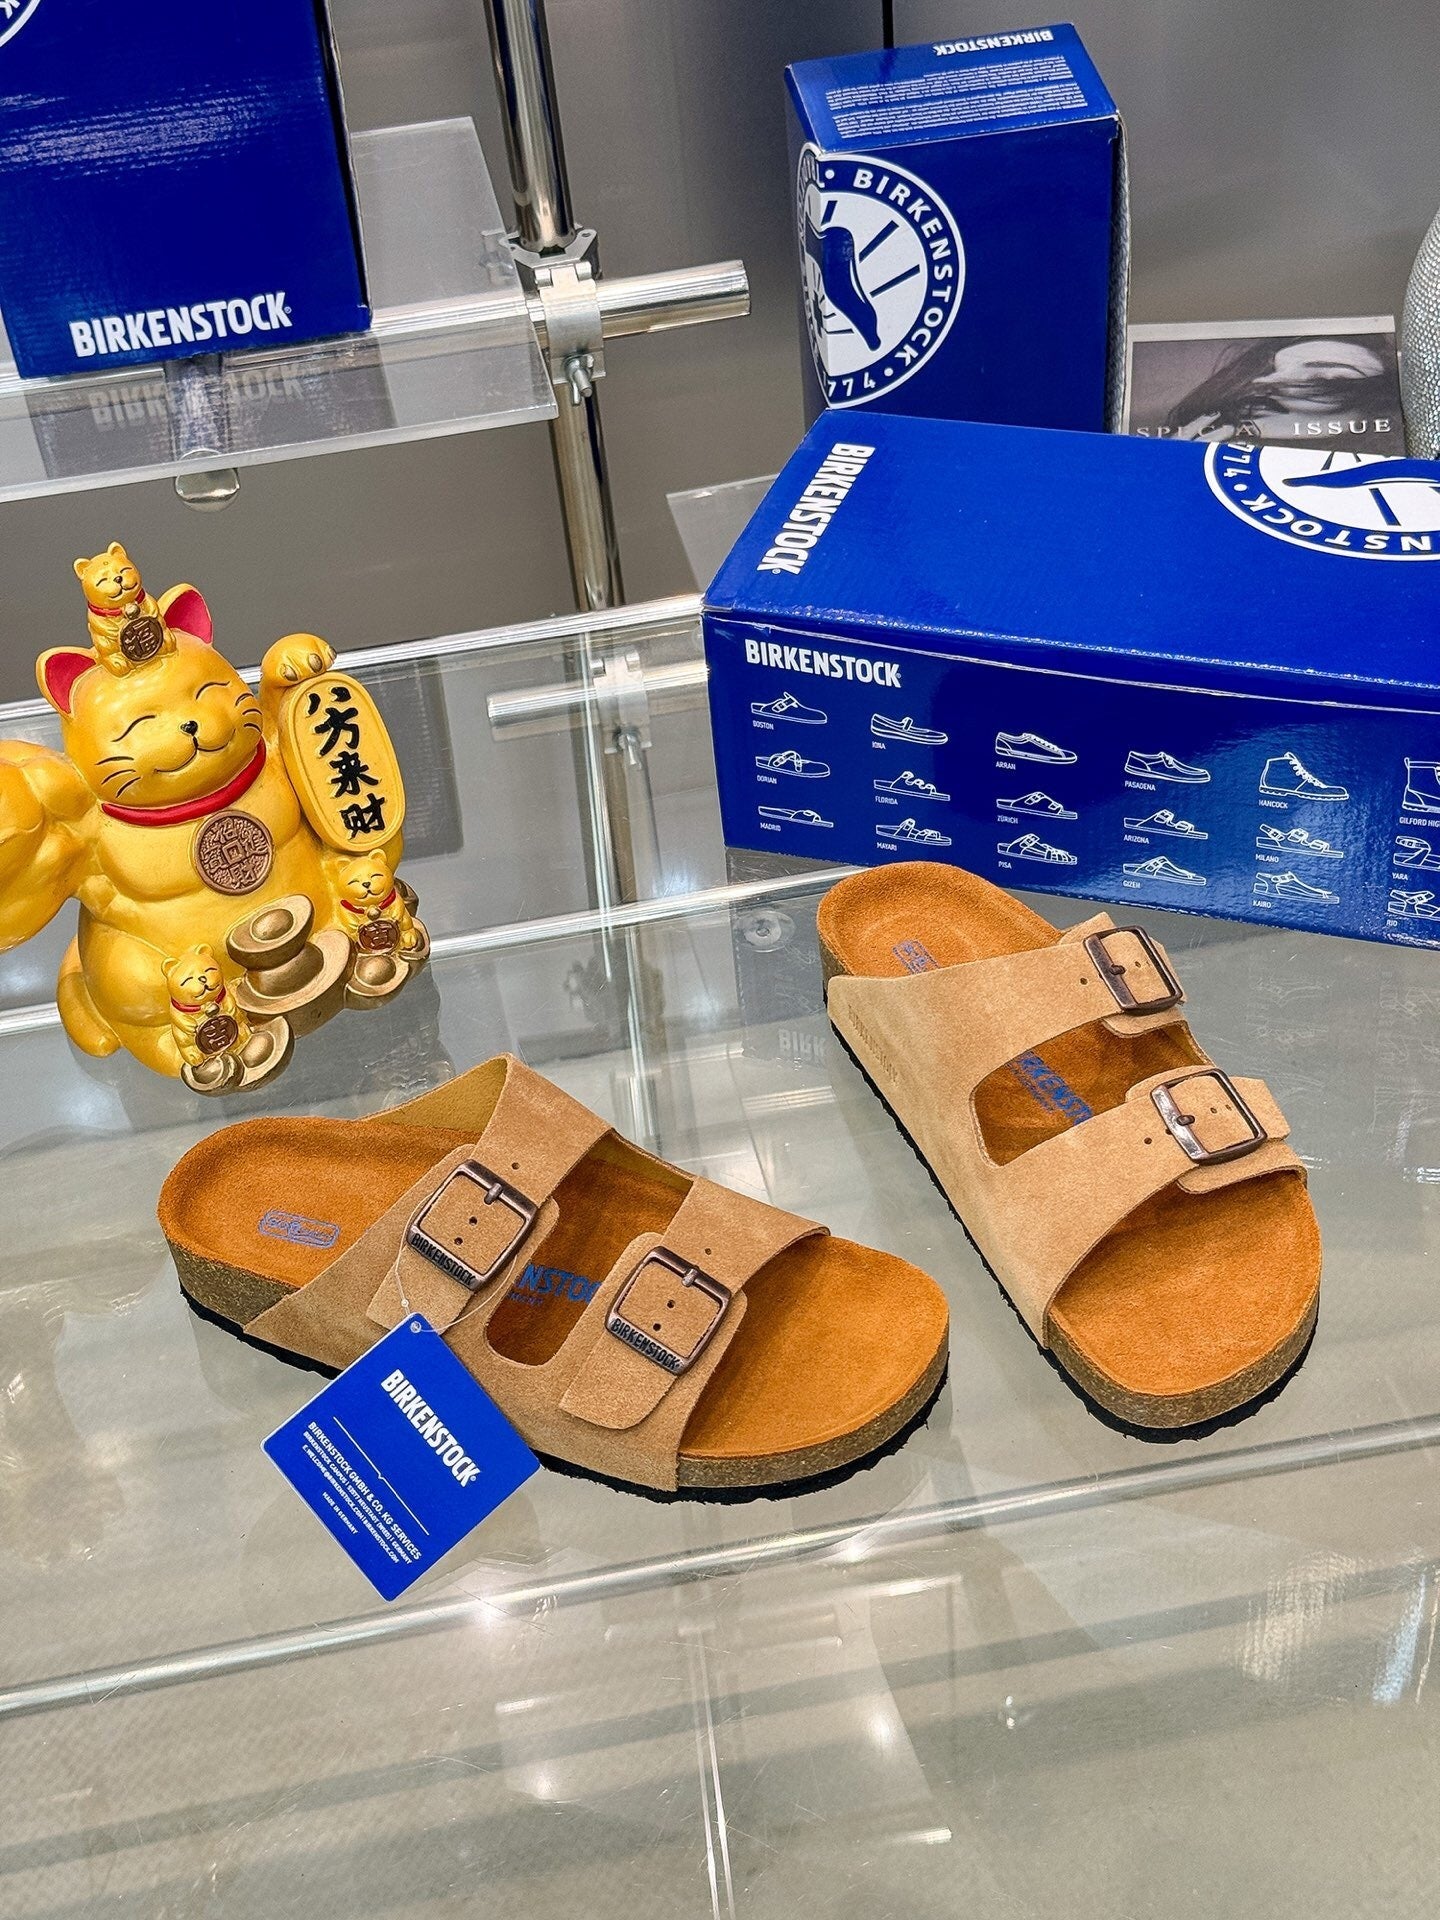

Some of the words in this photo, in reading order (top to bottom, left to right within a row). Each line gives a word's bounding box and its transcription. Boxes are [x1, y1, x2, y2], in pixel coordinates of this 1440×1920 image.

[935, 30, 1054, 57] BIRKENSTOCK
[853, 168, 953, 366] BIRKENSTOCK
[69, 292, 292, 358] BIRKENSTOCK
[1294, 419, 1391, 436] ISSUE
[757, 443, 876, 575] BIRKENSTOCK
[745, 638, 902, 688] BIRKENSTOCK
[752, 720, 774, 730] BOSTON
[995, 761, 1016, 770] ARRAN
[757, 775, 777, 784] DORIAN
[1124, 780, 1156, 791] PASADENA
[875, 796, 898, 805] FLORIDA
[1259, 799, 1288, 809] HANCOCK
[760, 822, 781, 832] MADRID
[1400, 817, 1427, 826] GILFORD
[1123, 834, 1149, 845] ARIZONA
[876, 842, 897, 851] MAYARI
[1255, 854, 1279, 863] MILANO
[998, 861, 1012, 870] PISA
[1123, 880, 1140, 889] GIZEH
[1253, 901, 1271, 909] KAIRO
[411, 1233, 476, 1287] BIRKENSTOCK
[611, 1318, 681, 1371] BIRKENSTOCK
[381, 1369, 481, 1487] BIRKENSTOCK
[308, 1422, 352, 1474] BIRKENSTOCK
[349, 1472, 370, 1495] GMBH
[367, 1493, 374, 1502] &
[372, 1500, 383, 1514] CO.
[381, 1512, 393, 1524] KG
[391, 1524, 421, 1559] SERVICES
[323, 1492, 335, 1506] MADE
[338, 1511, 358, 1534] GERMANY
